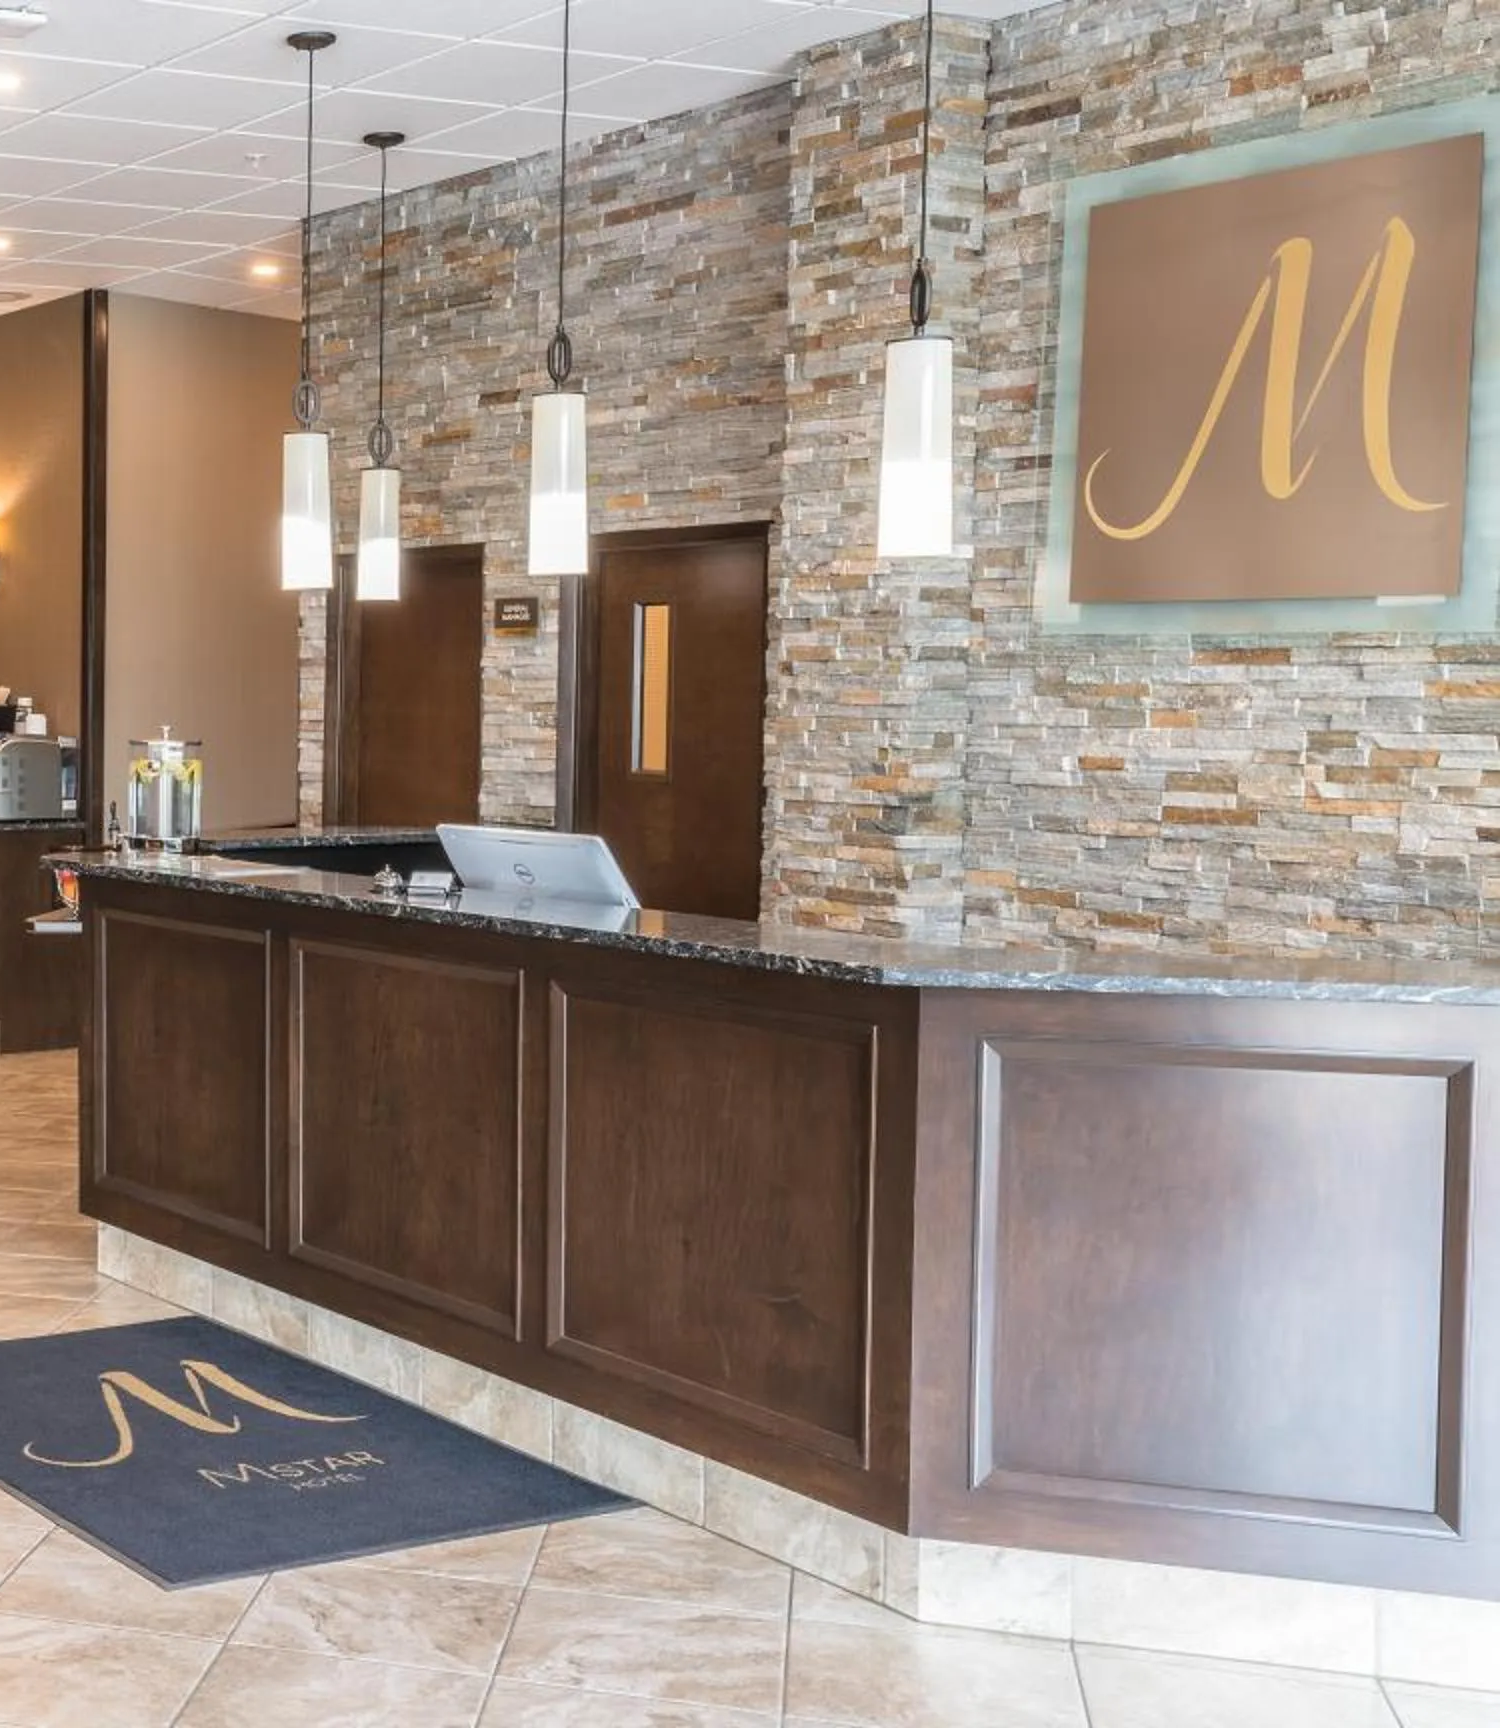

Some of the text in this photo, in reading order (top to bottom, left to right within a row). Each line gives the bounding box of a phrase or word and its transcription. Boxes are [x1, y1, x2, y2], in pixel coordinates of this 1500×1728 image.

[1084, 216, 1449, 540] M
[23, 1359, 372, 1467] M
[197, 1451, 385, 1489] MSTAR
